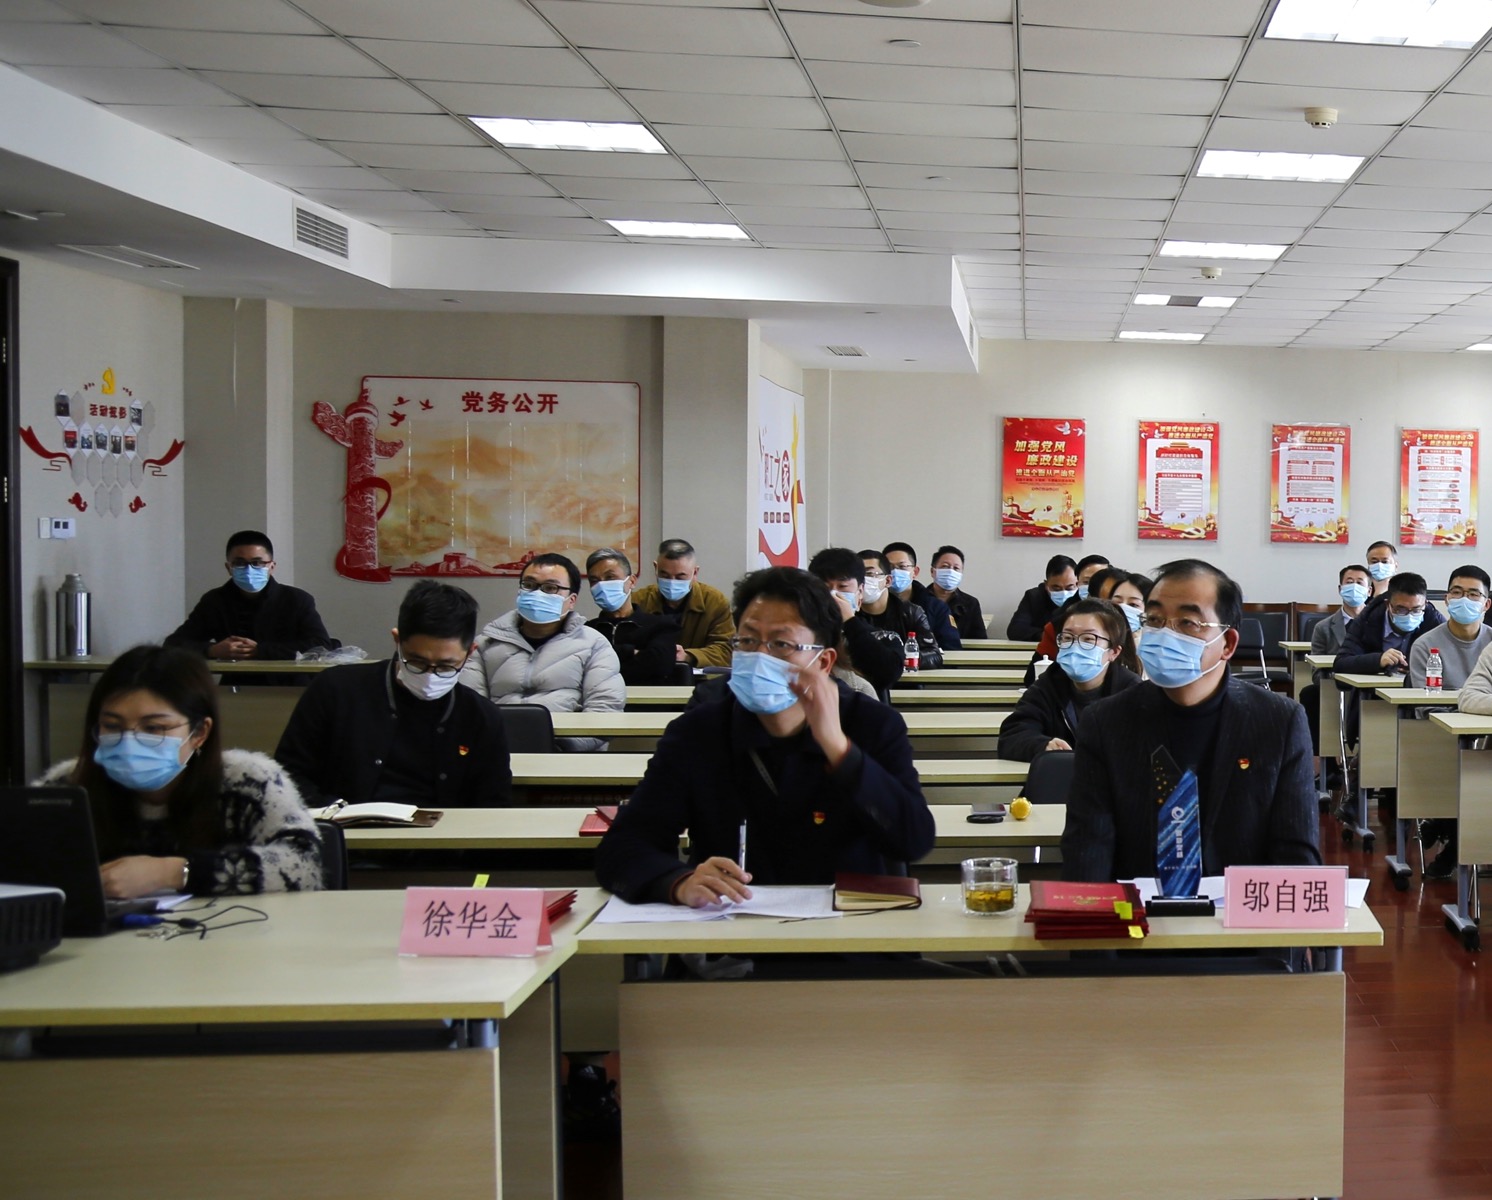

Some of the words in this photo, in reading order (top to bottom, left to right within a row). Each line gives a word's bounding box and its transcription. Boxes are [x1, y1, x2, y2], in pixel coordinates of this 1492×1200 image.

[461, 390, 560, 415] 党务公开
[1014, 440, 1066, 453] 加强党风
[1026, 454, 1078, 467] 廉政建设
[1015, 468, 1076, 478] 推进全面从严治党
[1243, 879, 1329, 913] 邬自强
[422, 900, 522, 939] 徐华金
